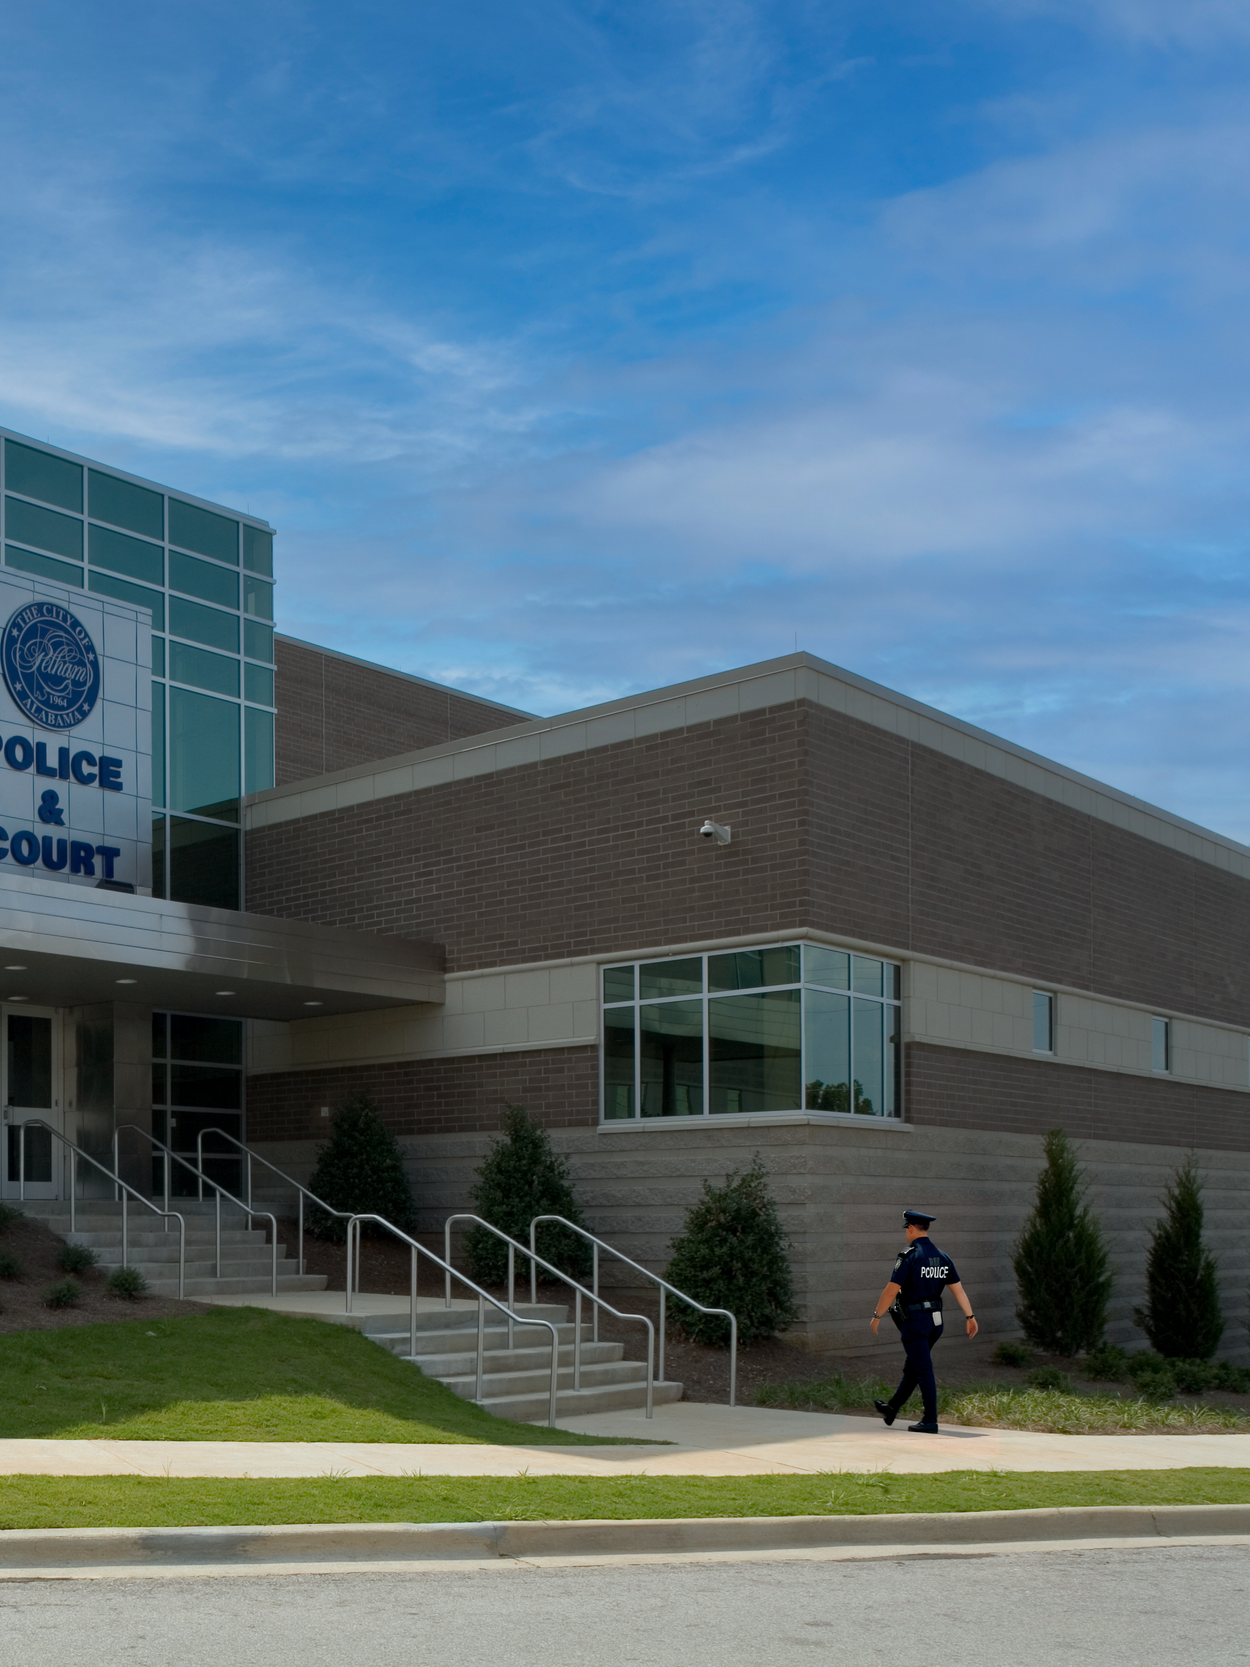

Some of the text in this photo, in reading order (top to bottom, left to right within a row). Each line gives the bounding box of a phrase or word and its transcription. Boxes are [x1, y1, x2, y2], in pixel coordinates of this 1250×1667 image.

[15, 605, 91, 647] THE CITY OF
[11, 632, 93, 684] Pelham
[22, 698, 83, 727] ALABAMA
[49, 695, 67, 708] 1964
[38, 789, 66, 826] &
